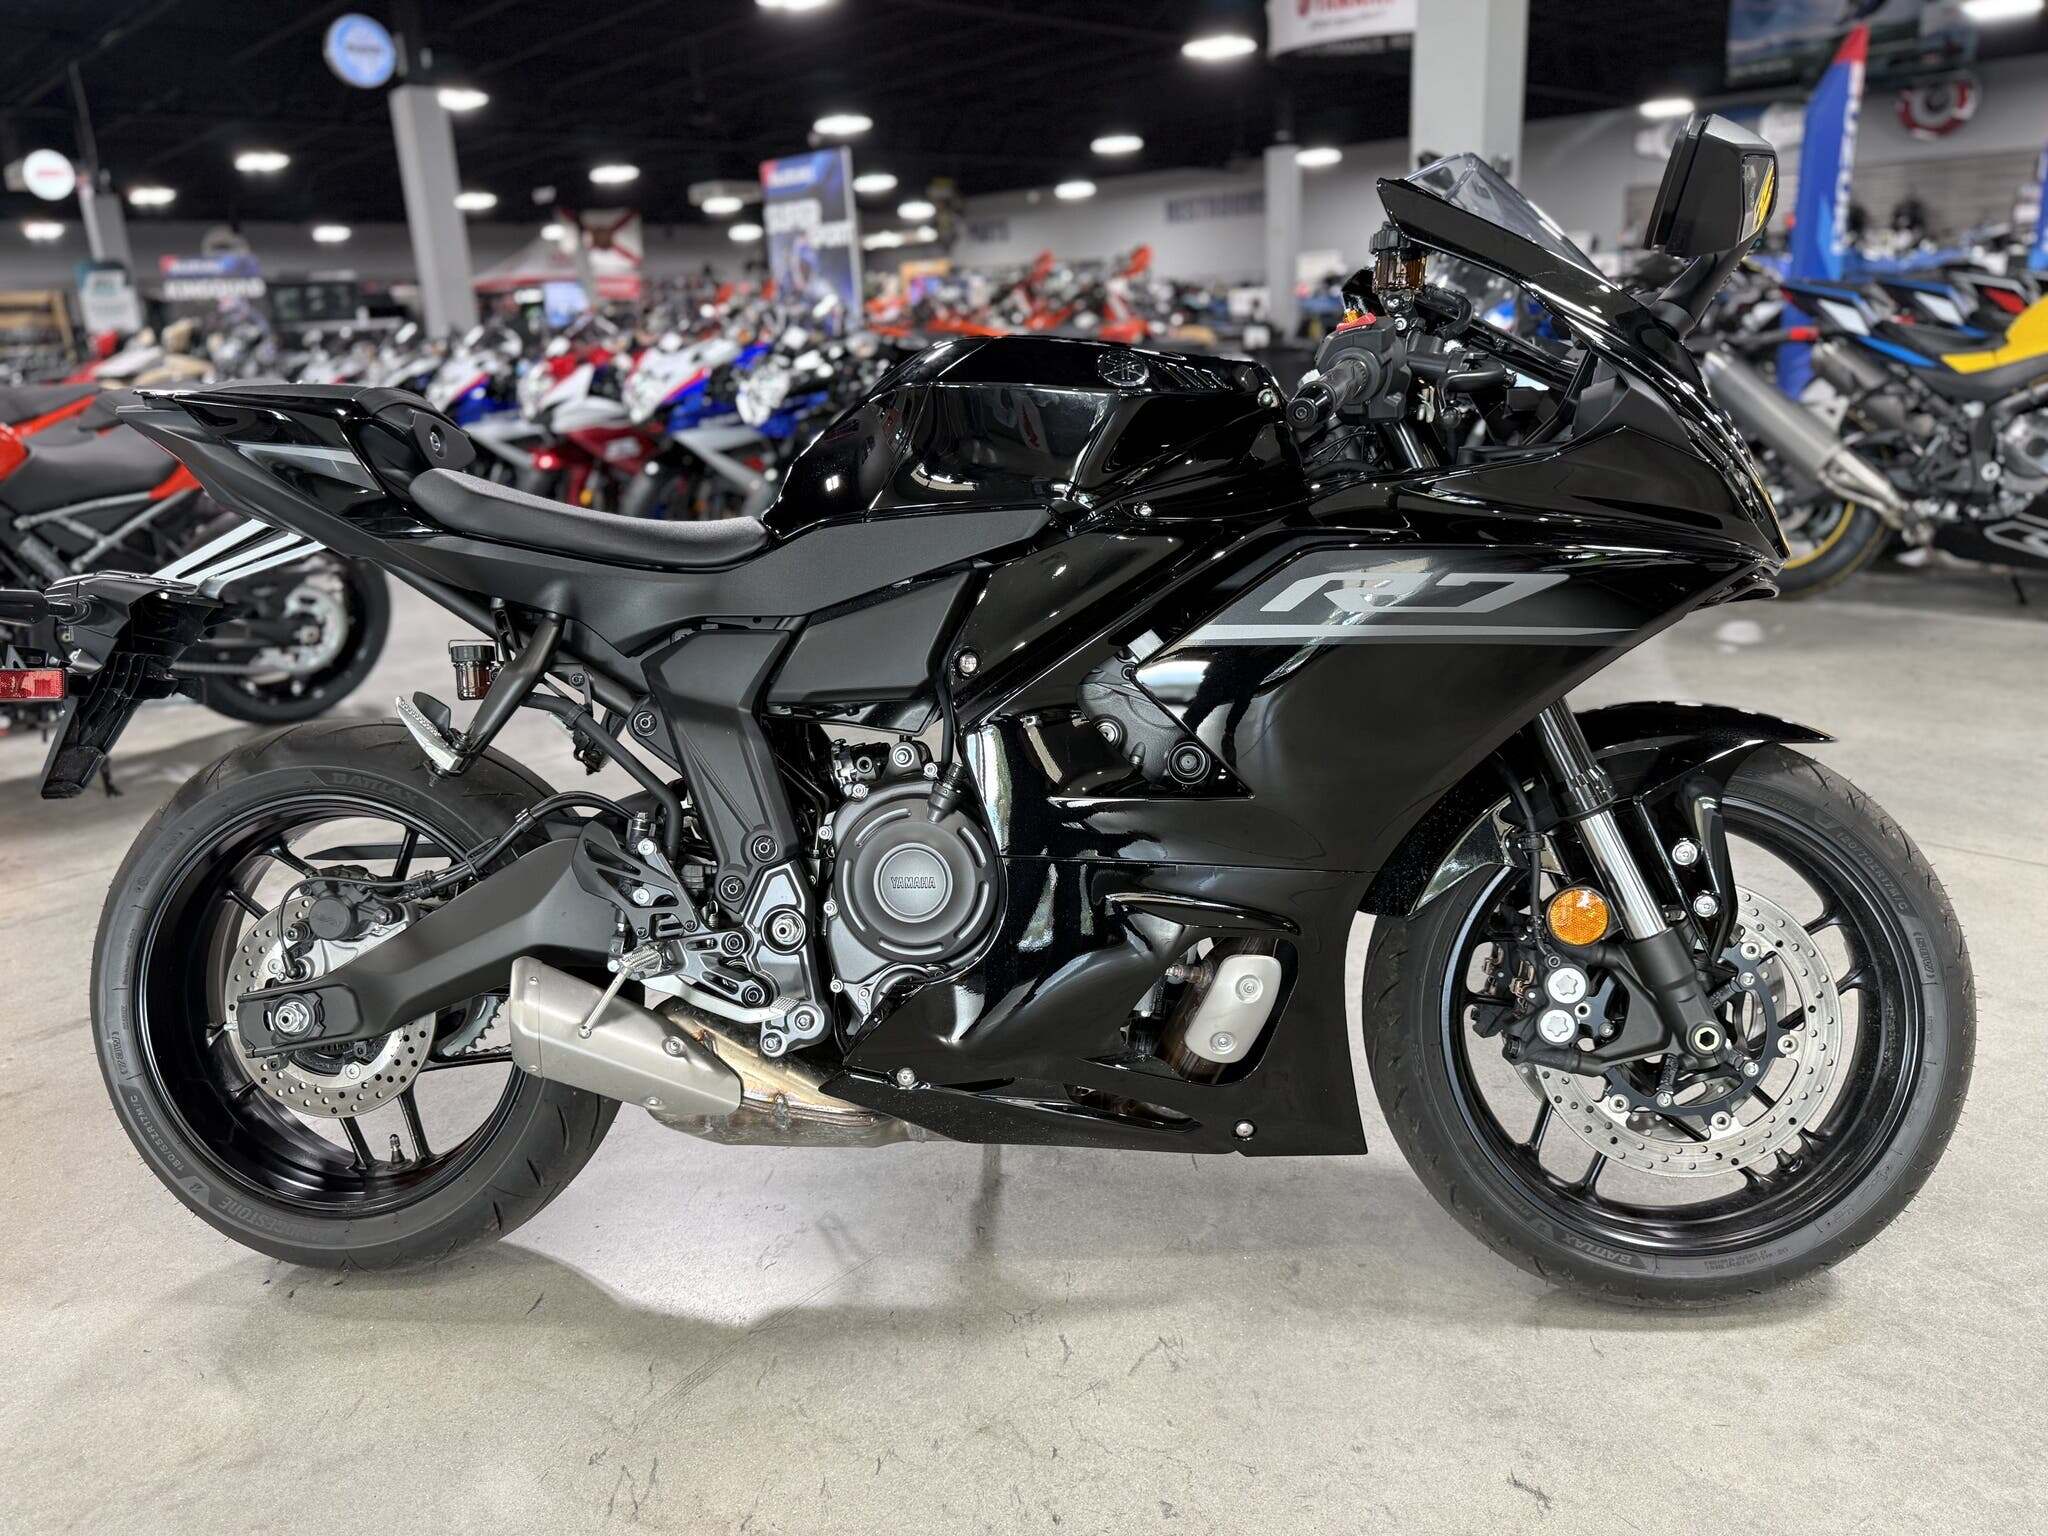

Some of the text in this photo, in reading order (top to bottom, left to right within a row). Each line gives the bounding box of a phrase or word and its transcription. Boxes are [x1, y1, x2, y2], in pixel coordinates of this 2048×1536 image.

[1260, 571, 1570, 613] R7
[890, 876, 936, 889] YAMAHA
[1563, 1232, 1633, 1265] BATTLAX
